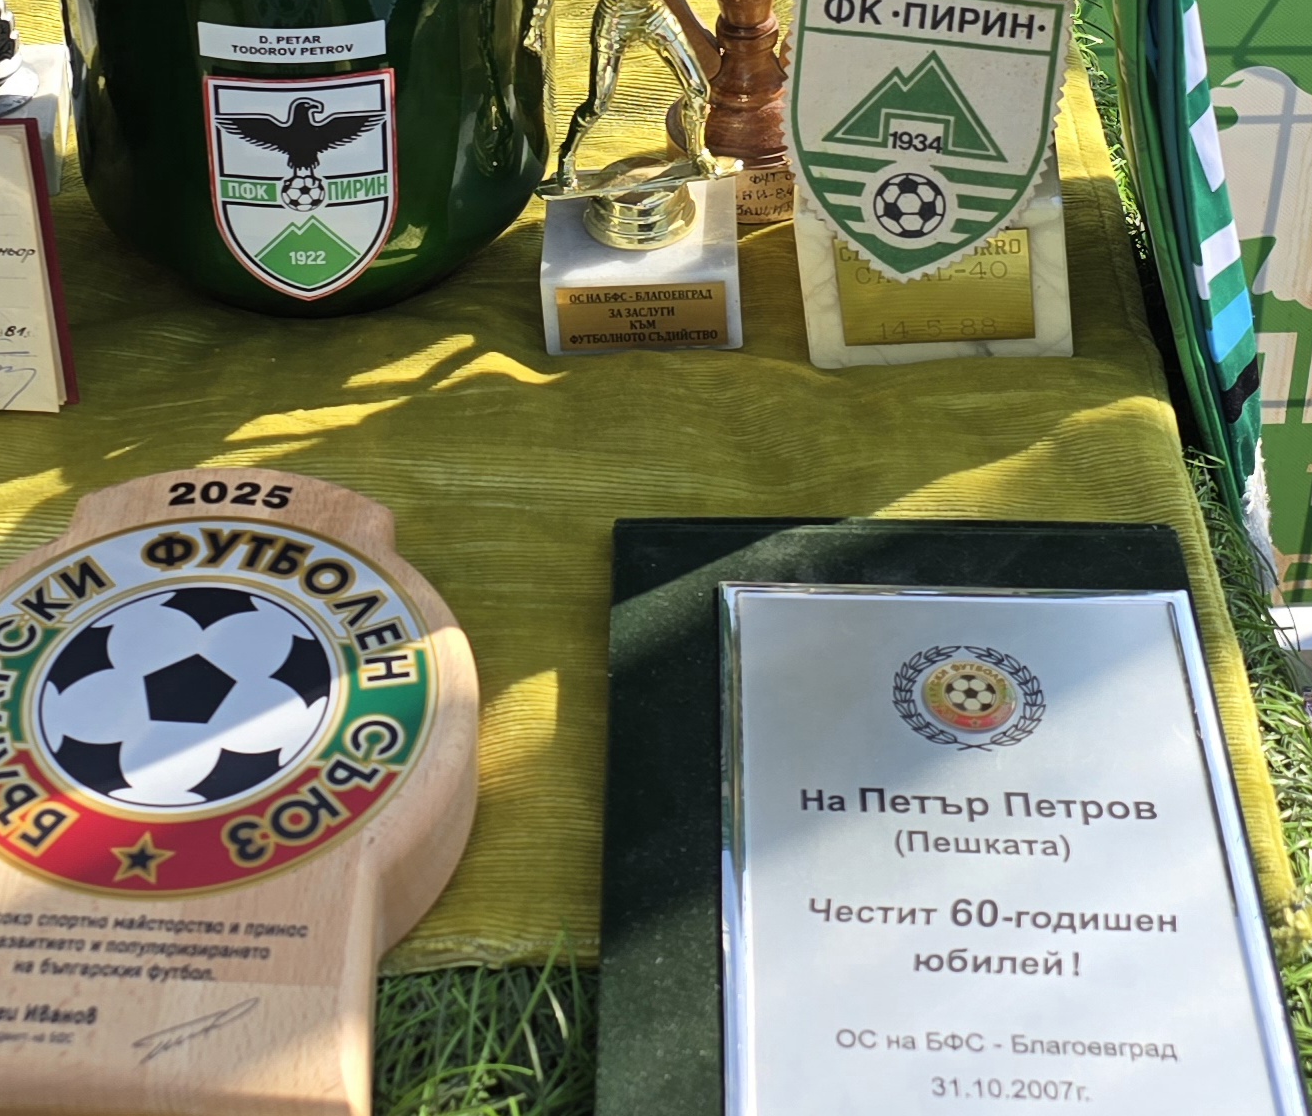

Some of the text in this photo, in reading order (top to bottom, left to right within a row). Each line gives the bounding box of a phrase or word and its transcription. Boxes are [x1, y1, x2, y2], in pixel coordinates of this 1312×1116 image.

[231, 43, 354, 56] TODOROV PETROV
[259, 35, 322, 46] D. PETAR
[889, 130, 944, 154] 1934
[228, 175, 388, 201] ПФК ПИРИН
[288, 250, 327, 266] 1922
[569, 293, 584, 304] ОС
[586, 293, 602, 303] НА
[604, 292, 627, 302] БФС
[635, 289, 713, 301] БЛАГОЕВГРАД
[608, 306, 675, 318] ЗА ЗАСЛУГИ
[569, 329, 718, 345] ФУТБОЛНОТО СЪДИЙСТВО
[629, 320, 657, 330] КЪМ
[880, 318, 997, 341] 14-5-88
[167, 481, 293, 510] 2025
[141, 527, 417, 687] ФУТБОЛЕН
[223, 716, 400, 865] СЪЮЗ
[800, 788, 1158, 825] На Петър Петров
[894, 829, 1072, 862] (Пешката)
[37, 915, 108, 931] спортно
[113, 914, 224, 935] майсторство
[229, 923, 239, 935] и
[244, 923, 309, 938] принос
[808, 897, 1178, 934] Честит 60-годишен
[90, 940, 101, 951] и
[106, 939, 271, 961] популяризирането
[13, 958, 216, 983] на българския футбол.
[24, 1002, 98, 1025] Иванов
[836, 1029, 877, 1050] ОС
[887, 1034, 916, 1052] на
[926, 1031, 984, 1053] БФС
[1011, 1034, 1178, 1062] Благоевград
[931, 1076, 1092, 1102] 31.10.2007г.
